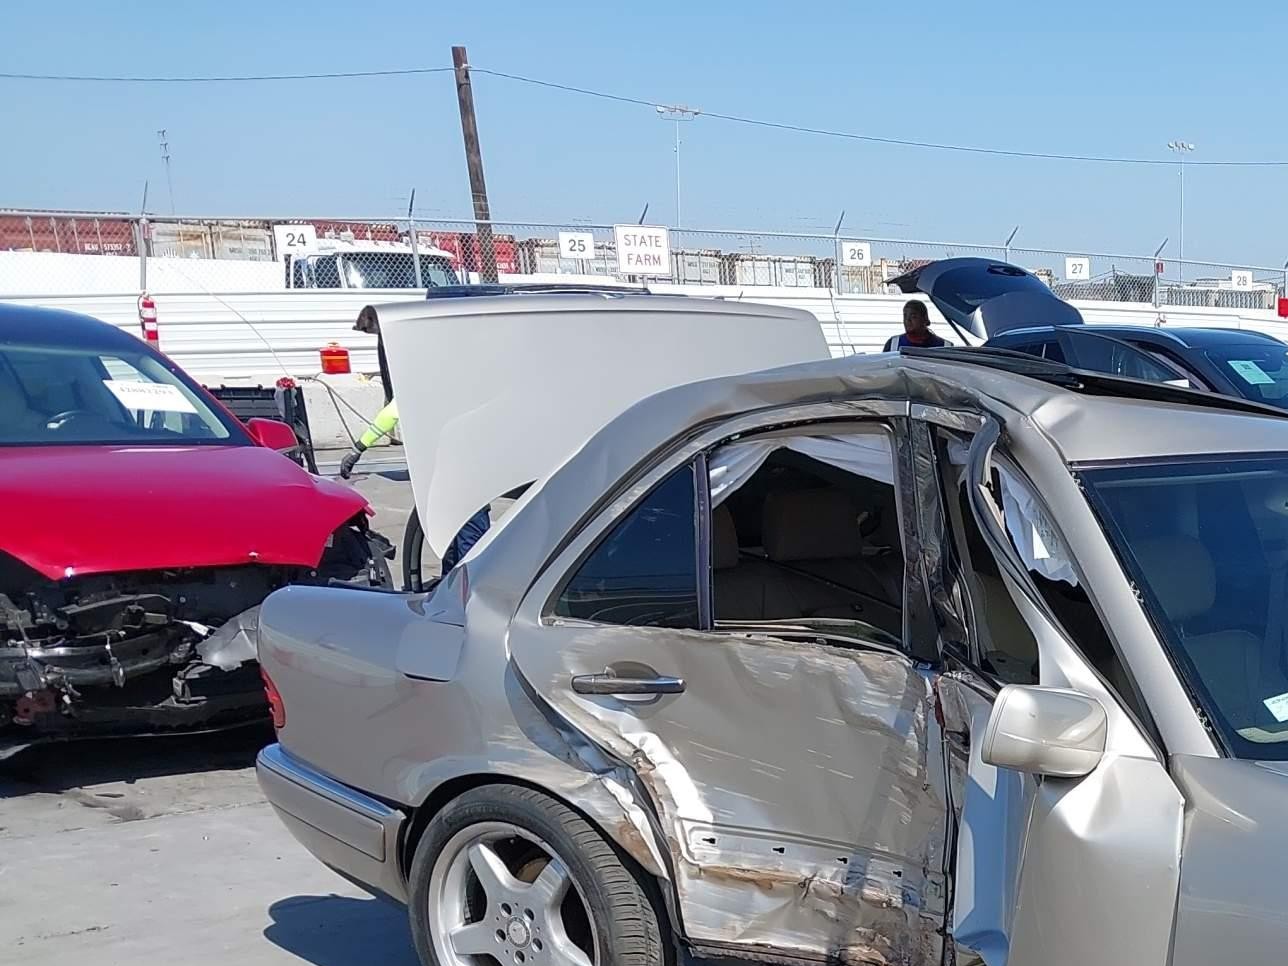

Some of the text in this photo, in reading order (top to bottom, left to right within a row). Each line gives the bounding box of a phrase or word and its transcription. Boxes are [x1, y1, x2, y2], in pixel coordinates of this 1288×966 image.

[286, 232, 306, 247] 24
[568, 239, 586, 252] 25
[623, 234, 662, 248] STATE
[627, 253, 662, 267] FARM
[849, 248, 864, 260] 26
[1071, 264, 1084, 274] 27
